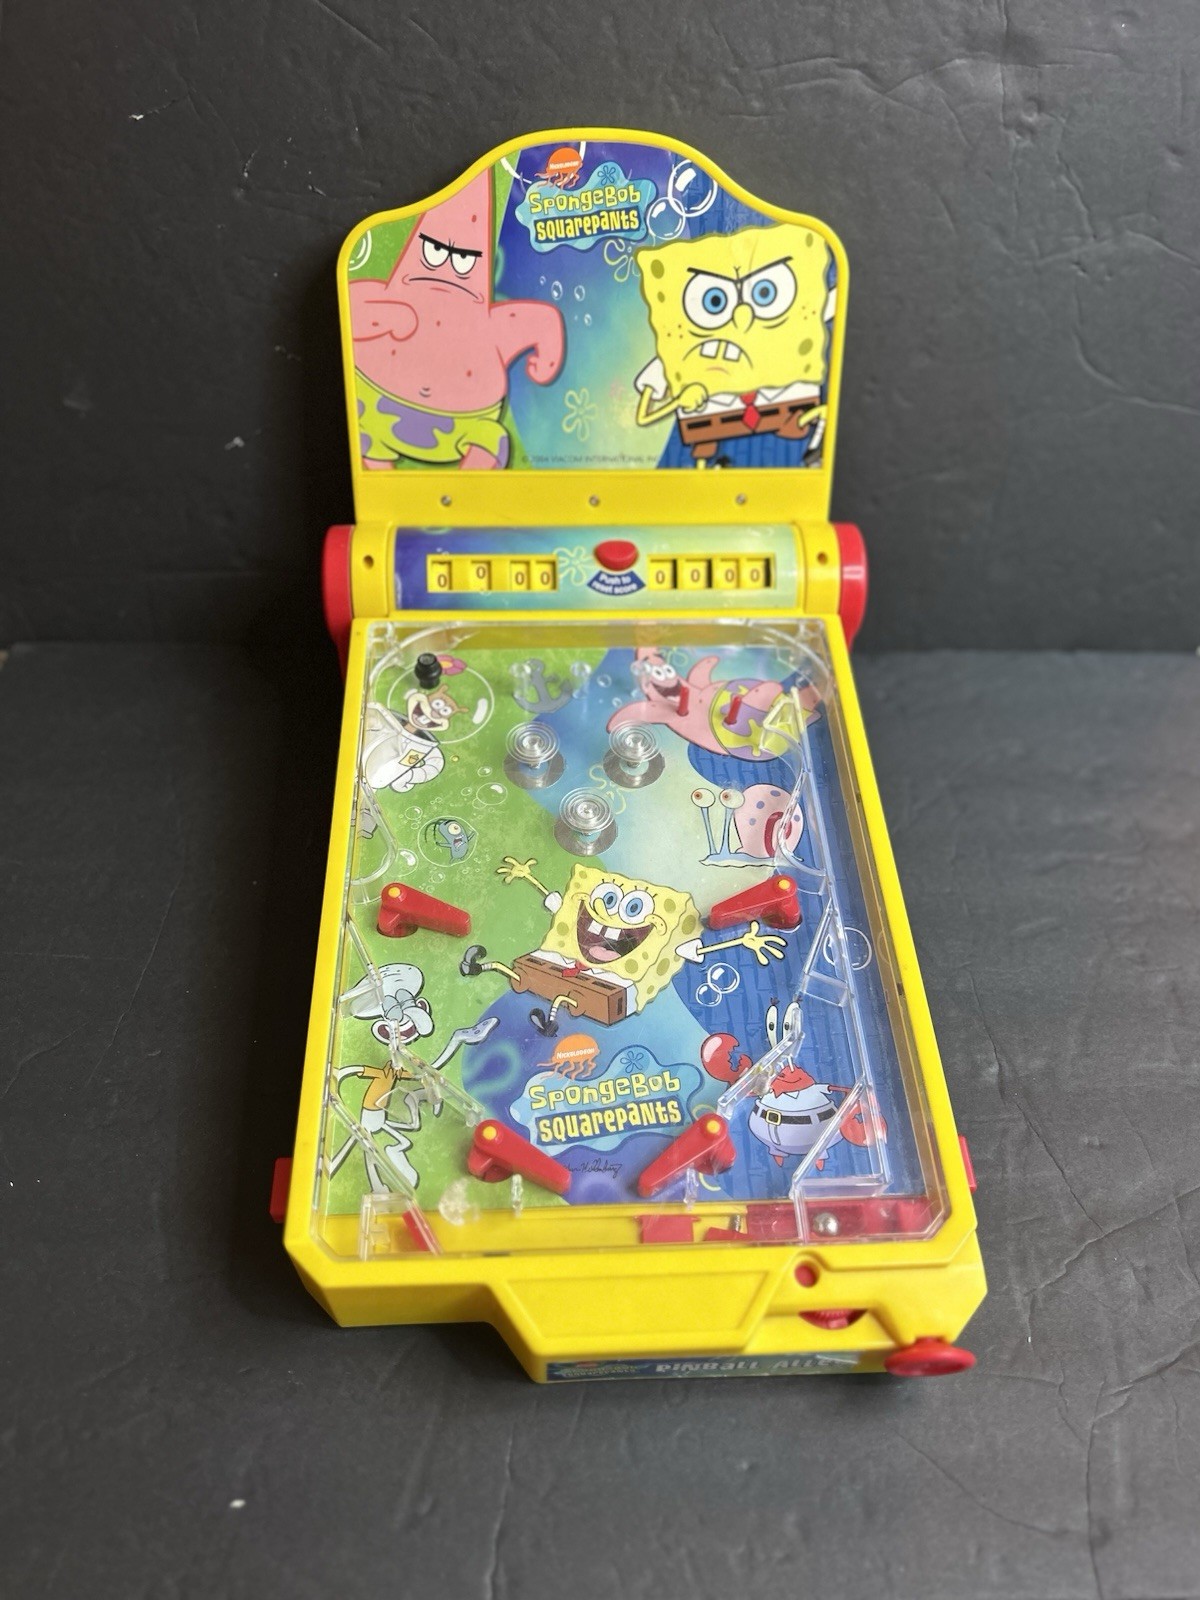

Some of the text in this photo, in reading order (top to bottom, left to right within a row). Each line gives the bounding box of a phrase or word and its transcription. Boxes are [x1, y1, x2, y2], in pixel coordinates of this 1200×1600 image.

[528, 184, 642, 215] SpongeBob
[437, 566, 551, 588] 0 0 0 0
[655, 568, 760, 585] 0 0 0 0
[528, 1069, 682, 1111] SpongeBob
